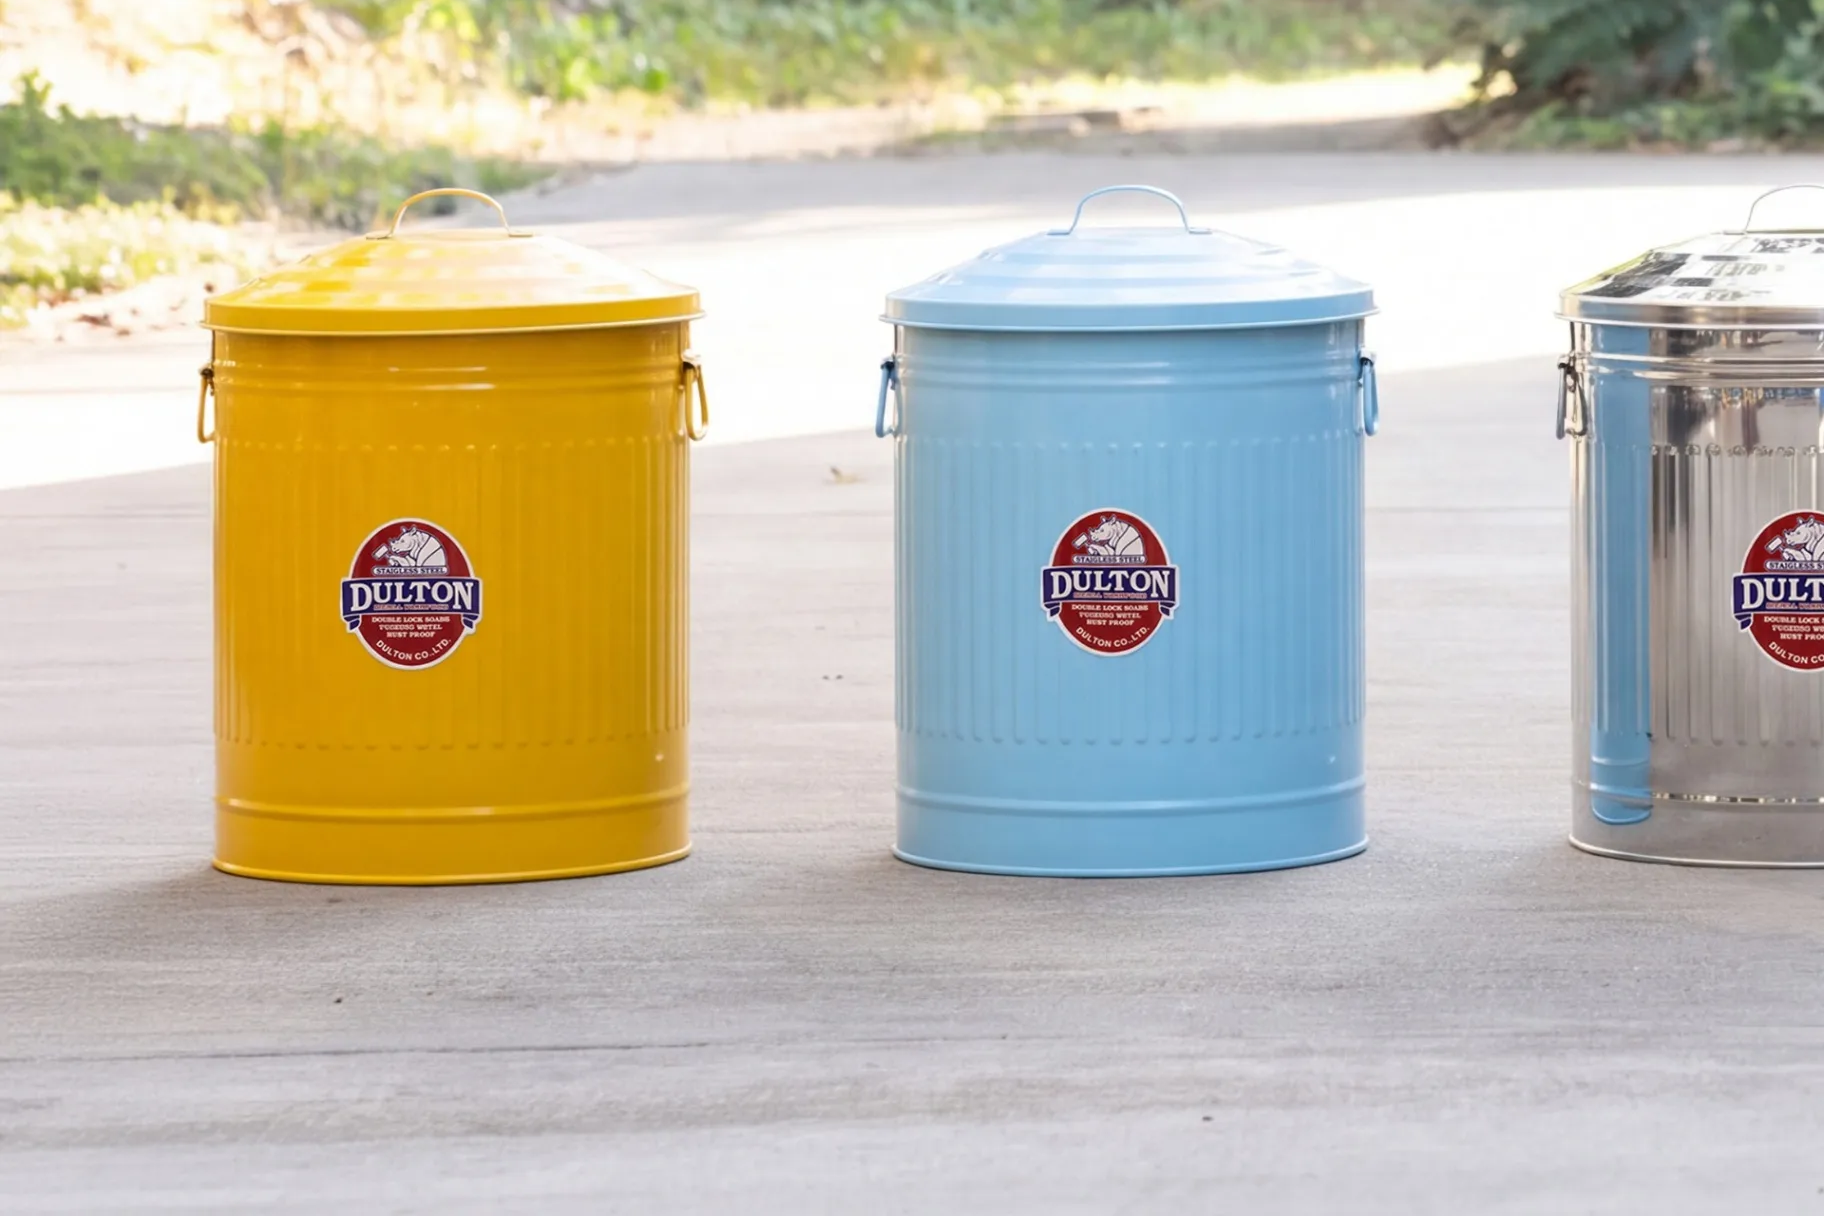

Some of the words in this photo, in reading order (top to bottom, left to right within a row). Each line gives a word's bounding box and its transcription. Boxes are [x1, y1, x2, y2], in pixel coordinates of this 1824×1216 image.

[1050, 570, 1170, 599] DULTON
[350, 581, 474, 612] DULTON
[1076, 627, 1112, 647] DULTON
[376, 639, 412, 660] DULTON
[1768, 641, 1808, 664] DULTON
